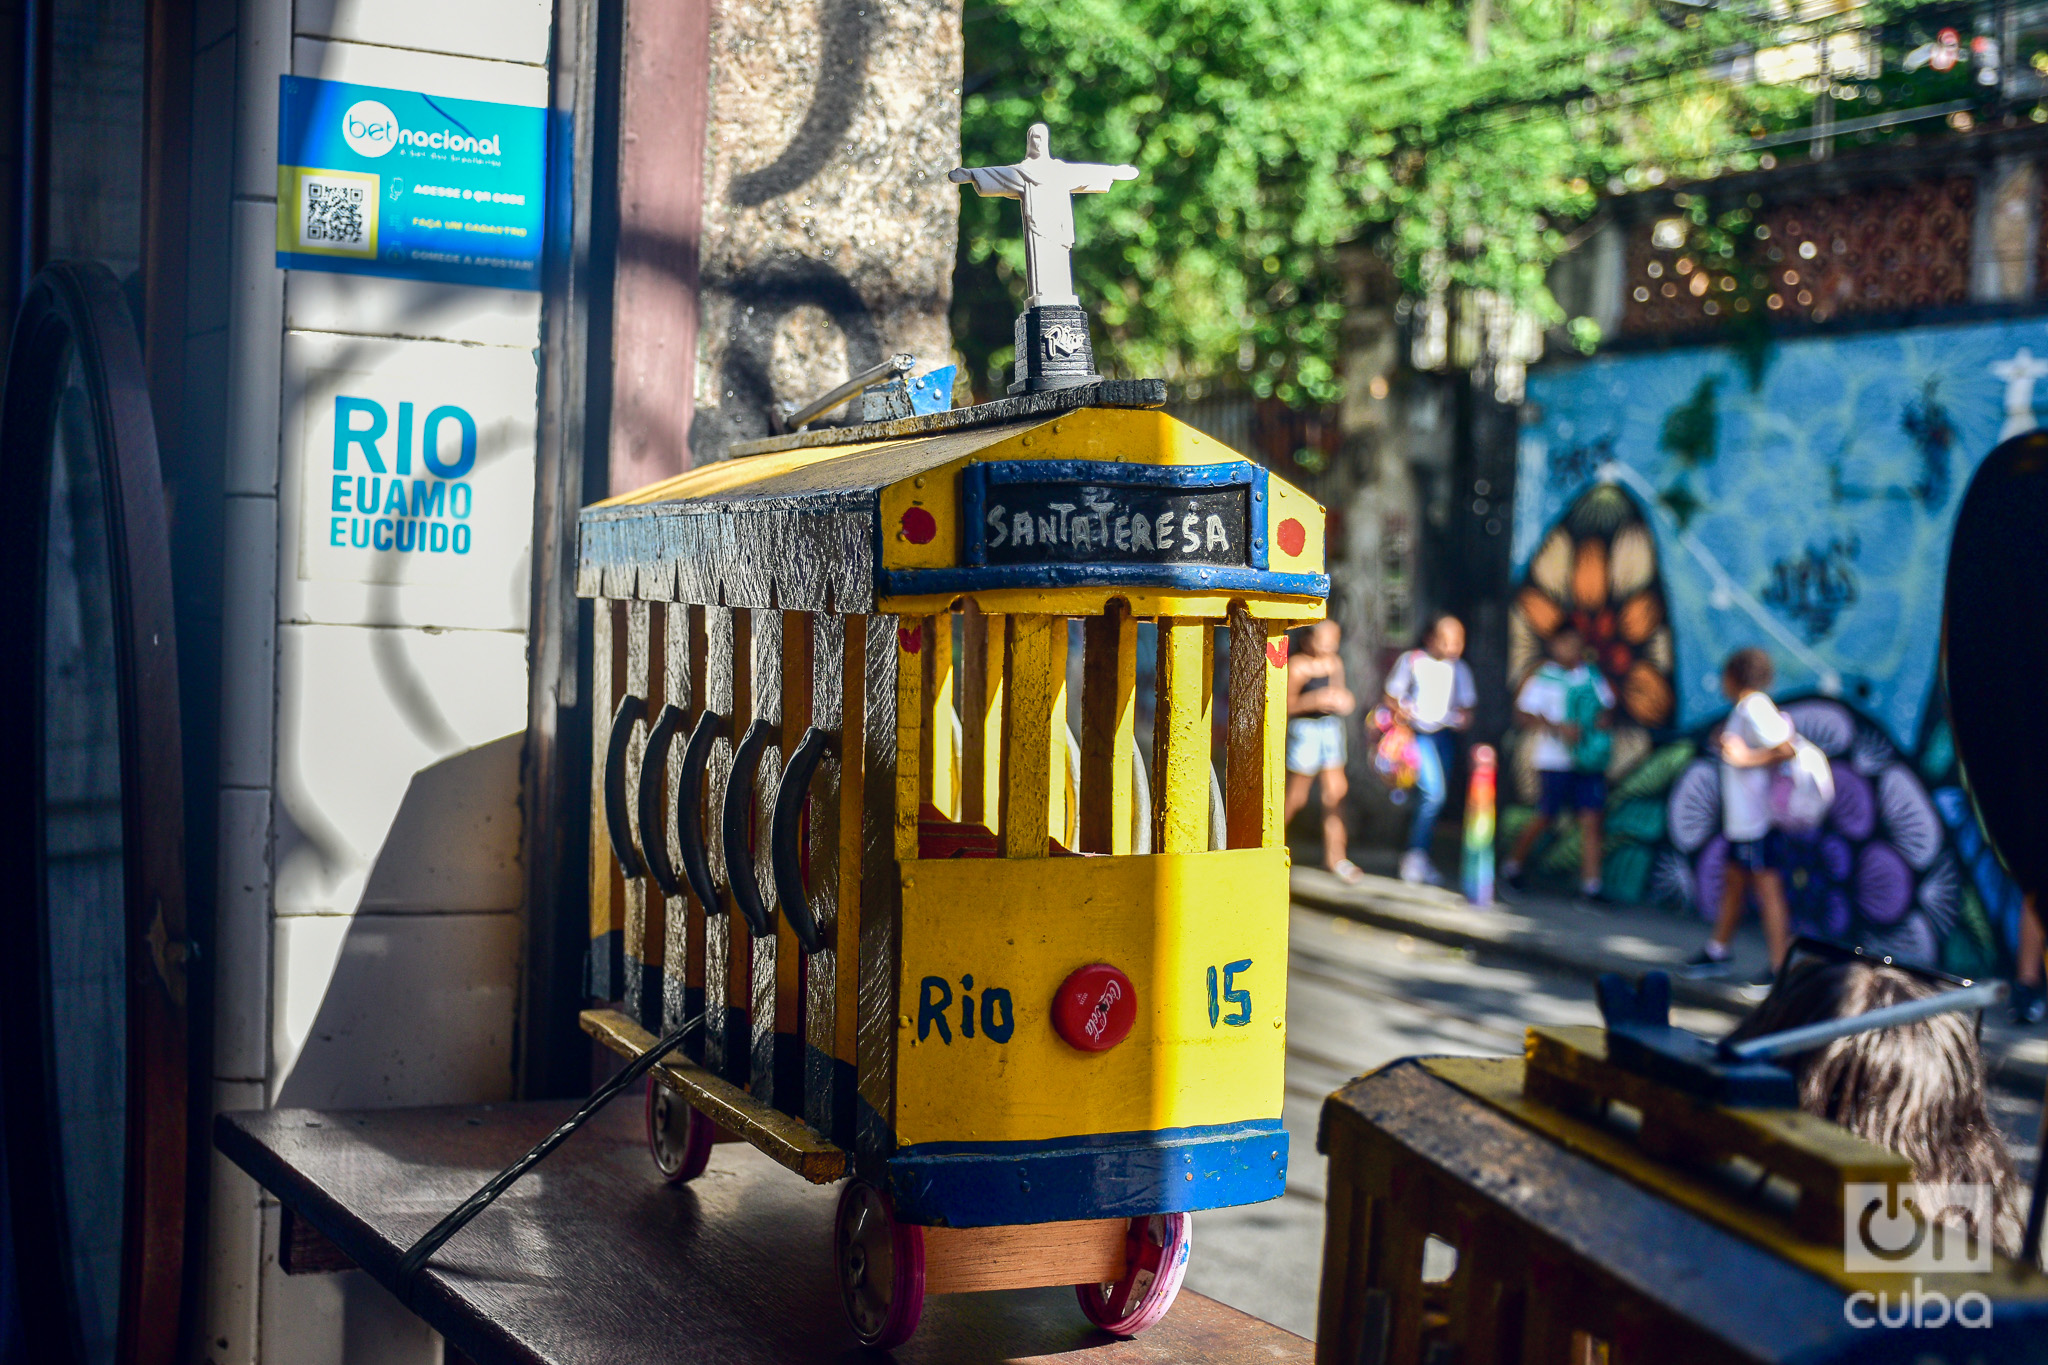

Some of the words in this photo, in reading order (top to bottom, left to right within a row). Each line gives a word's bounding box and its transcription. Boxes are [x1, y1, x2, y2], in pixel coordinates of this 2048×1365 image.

[464, 222, 527, 237] CADASTRO
[1044, 324, 1086, 358] Rio
[333, 395, 477, 479] RIO
[918, 974, 1015, 1046] Rio
[1206, 958, 1253, 1029] 15
